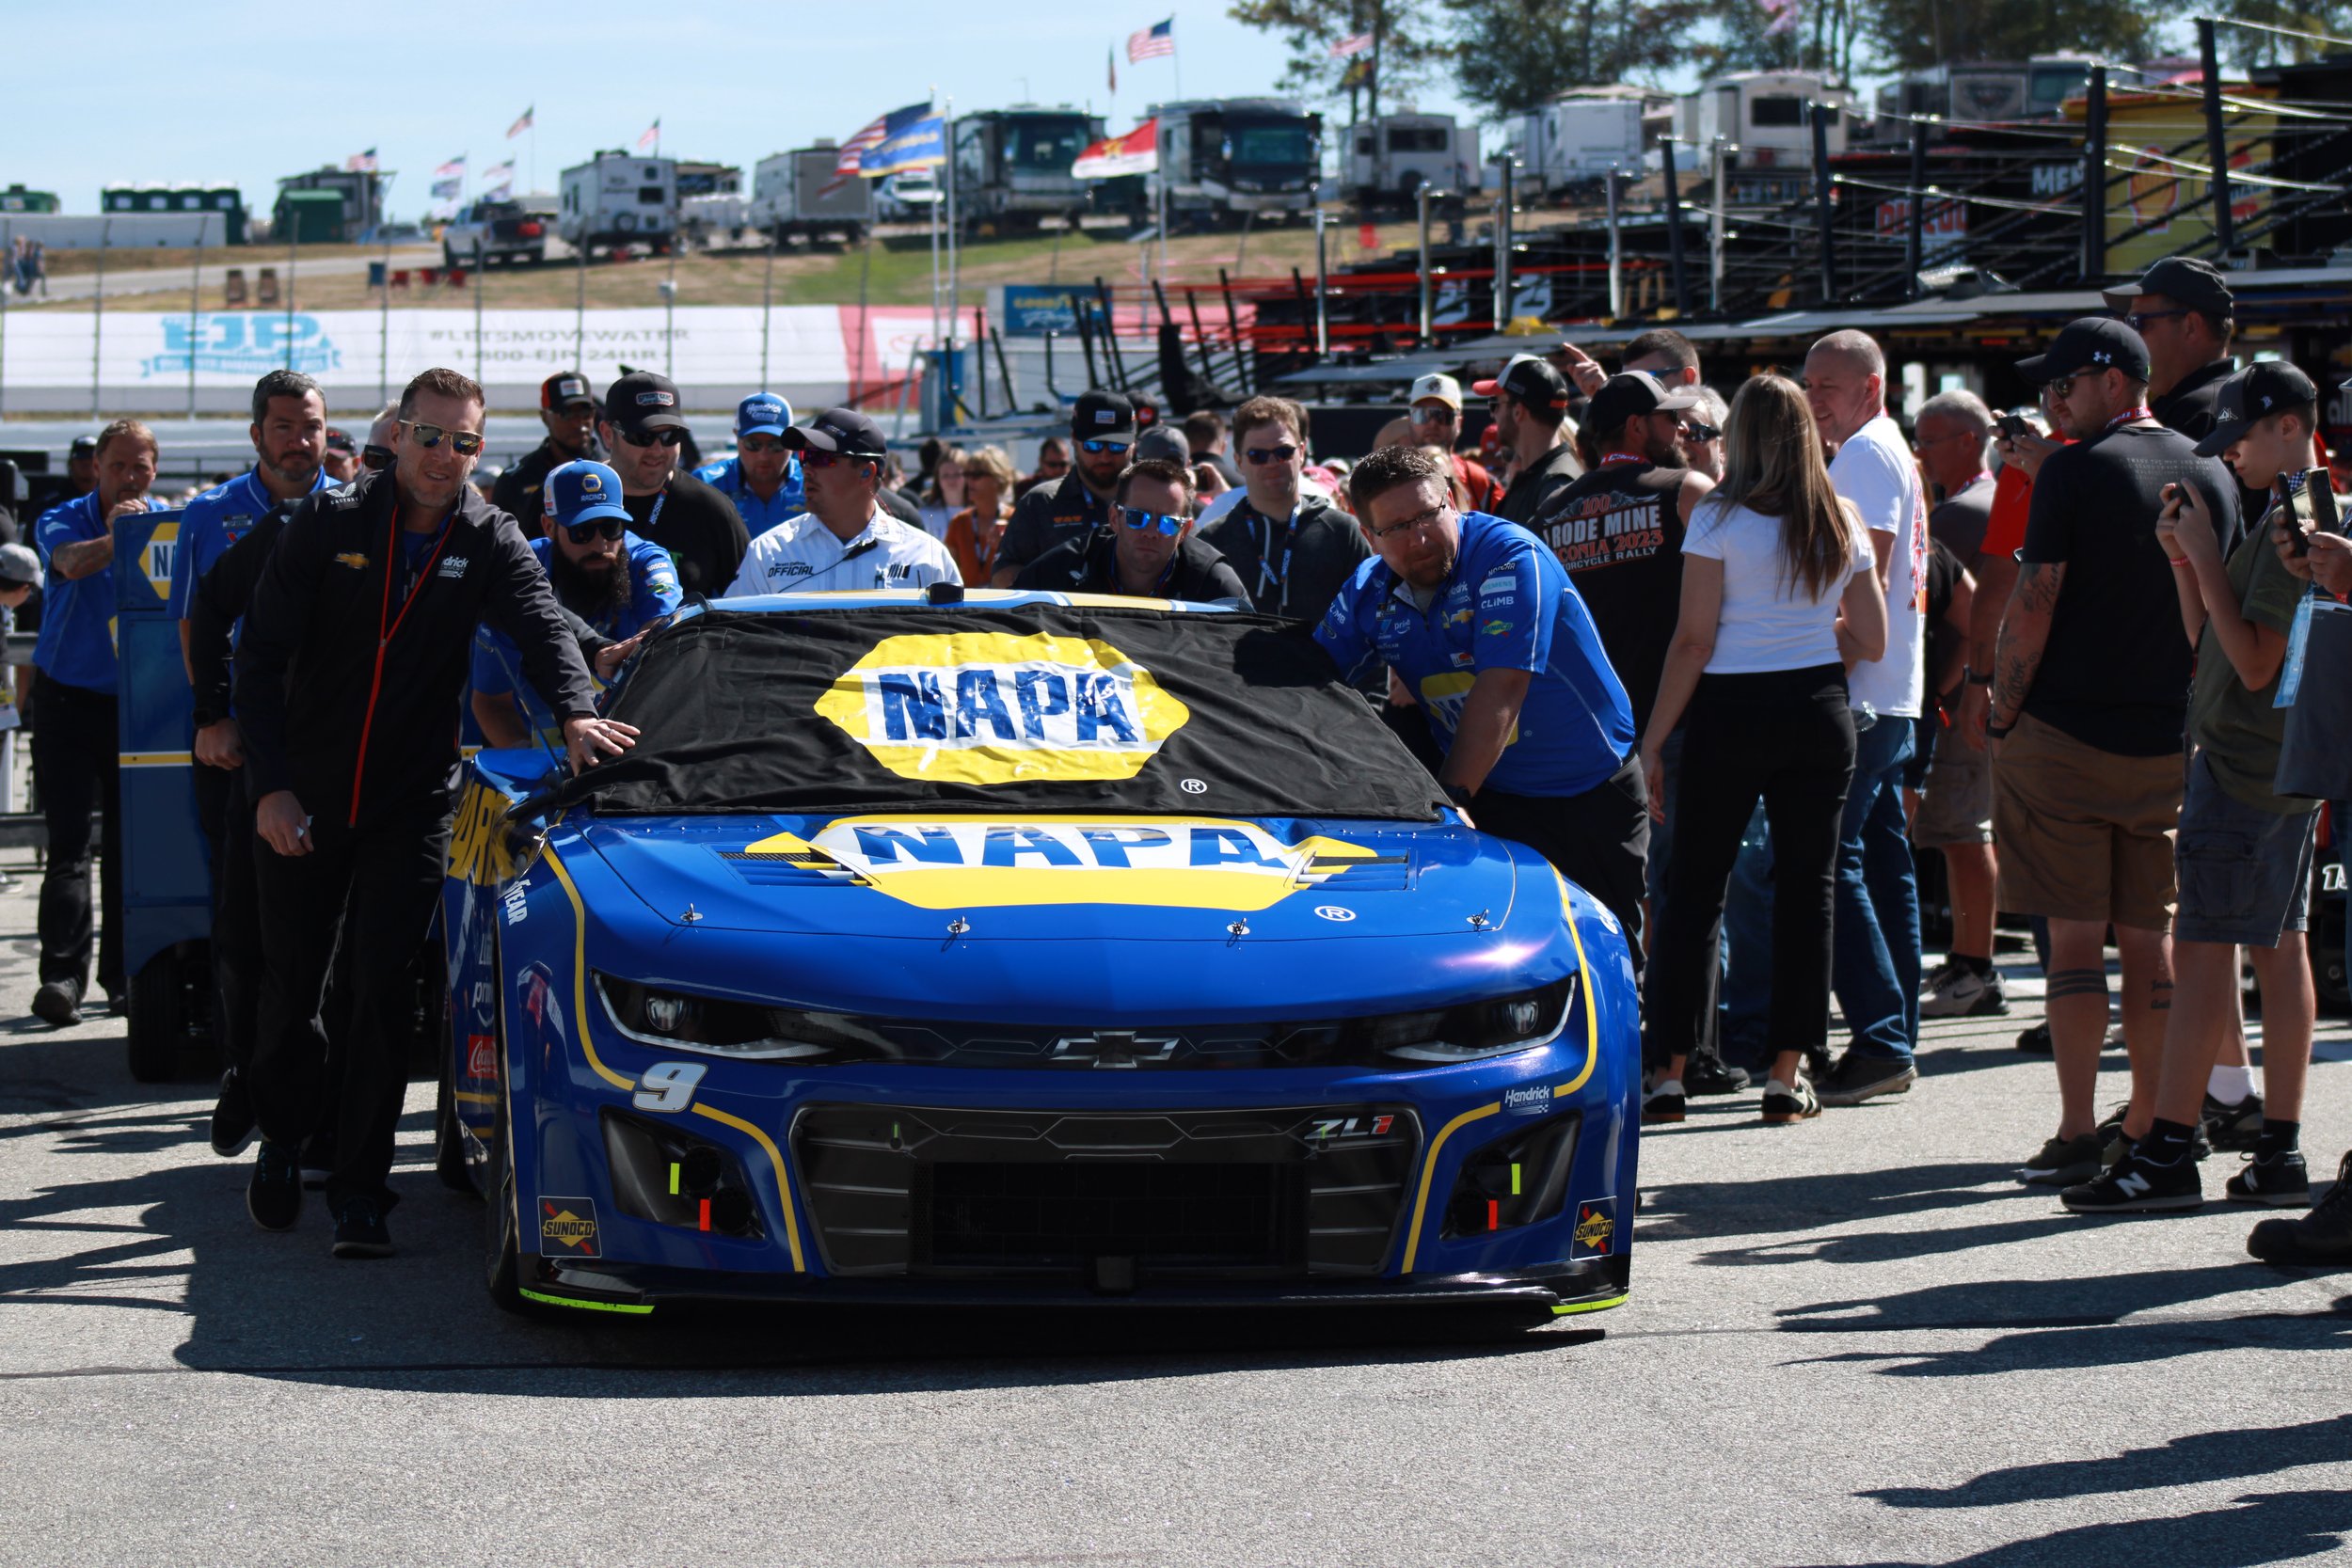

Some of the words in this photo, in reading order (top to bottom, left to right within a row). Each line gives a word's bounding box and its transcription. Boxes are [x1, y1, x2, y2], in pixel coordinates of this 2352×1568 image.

[1580, 495, 1612, 515] 100
[1604, 505, 1661, 537] MINE
[1554, 539, 1610, 562] CONIA
[1614, 530, 1663, 552] 2023
[1565, 556, 1611, 570] ORCYCLE
[1616, 546, 1657, 561] RALLY
[768, 566, 814, 578] OFFICIAL
[878, 670, 1139, 743] NAPA
[852, 825, 1293, 869] NAPA
[633, 1061, 708, 1113] 9
[1505, 1085, 1549, 1108] Hendrick
[1304, 1115, 1394, 1139] ZL1
[544, 1220, 595, 1238] SUNOCO
[1576, 1219, 1613, 1241] SUNOCO
